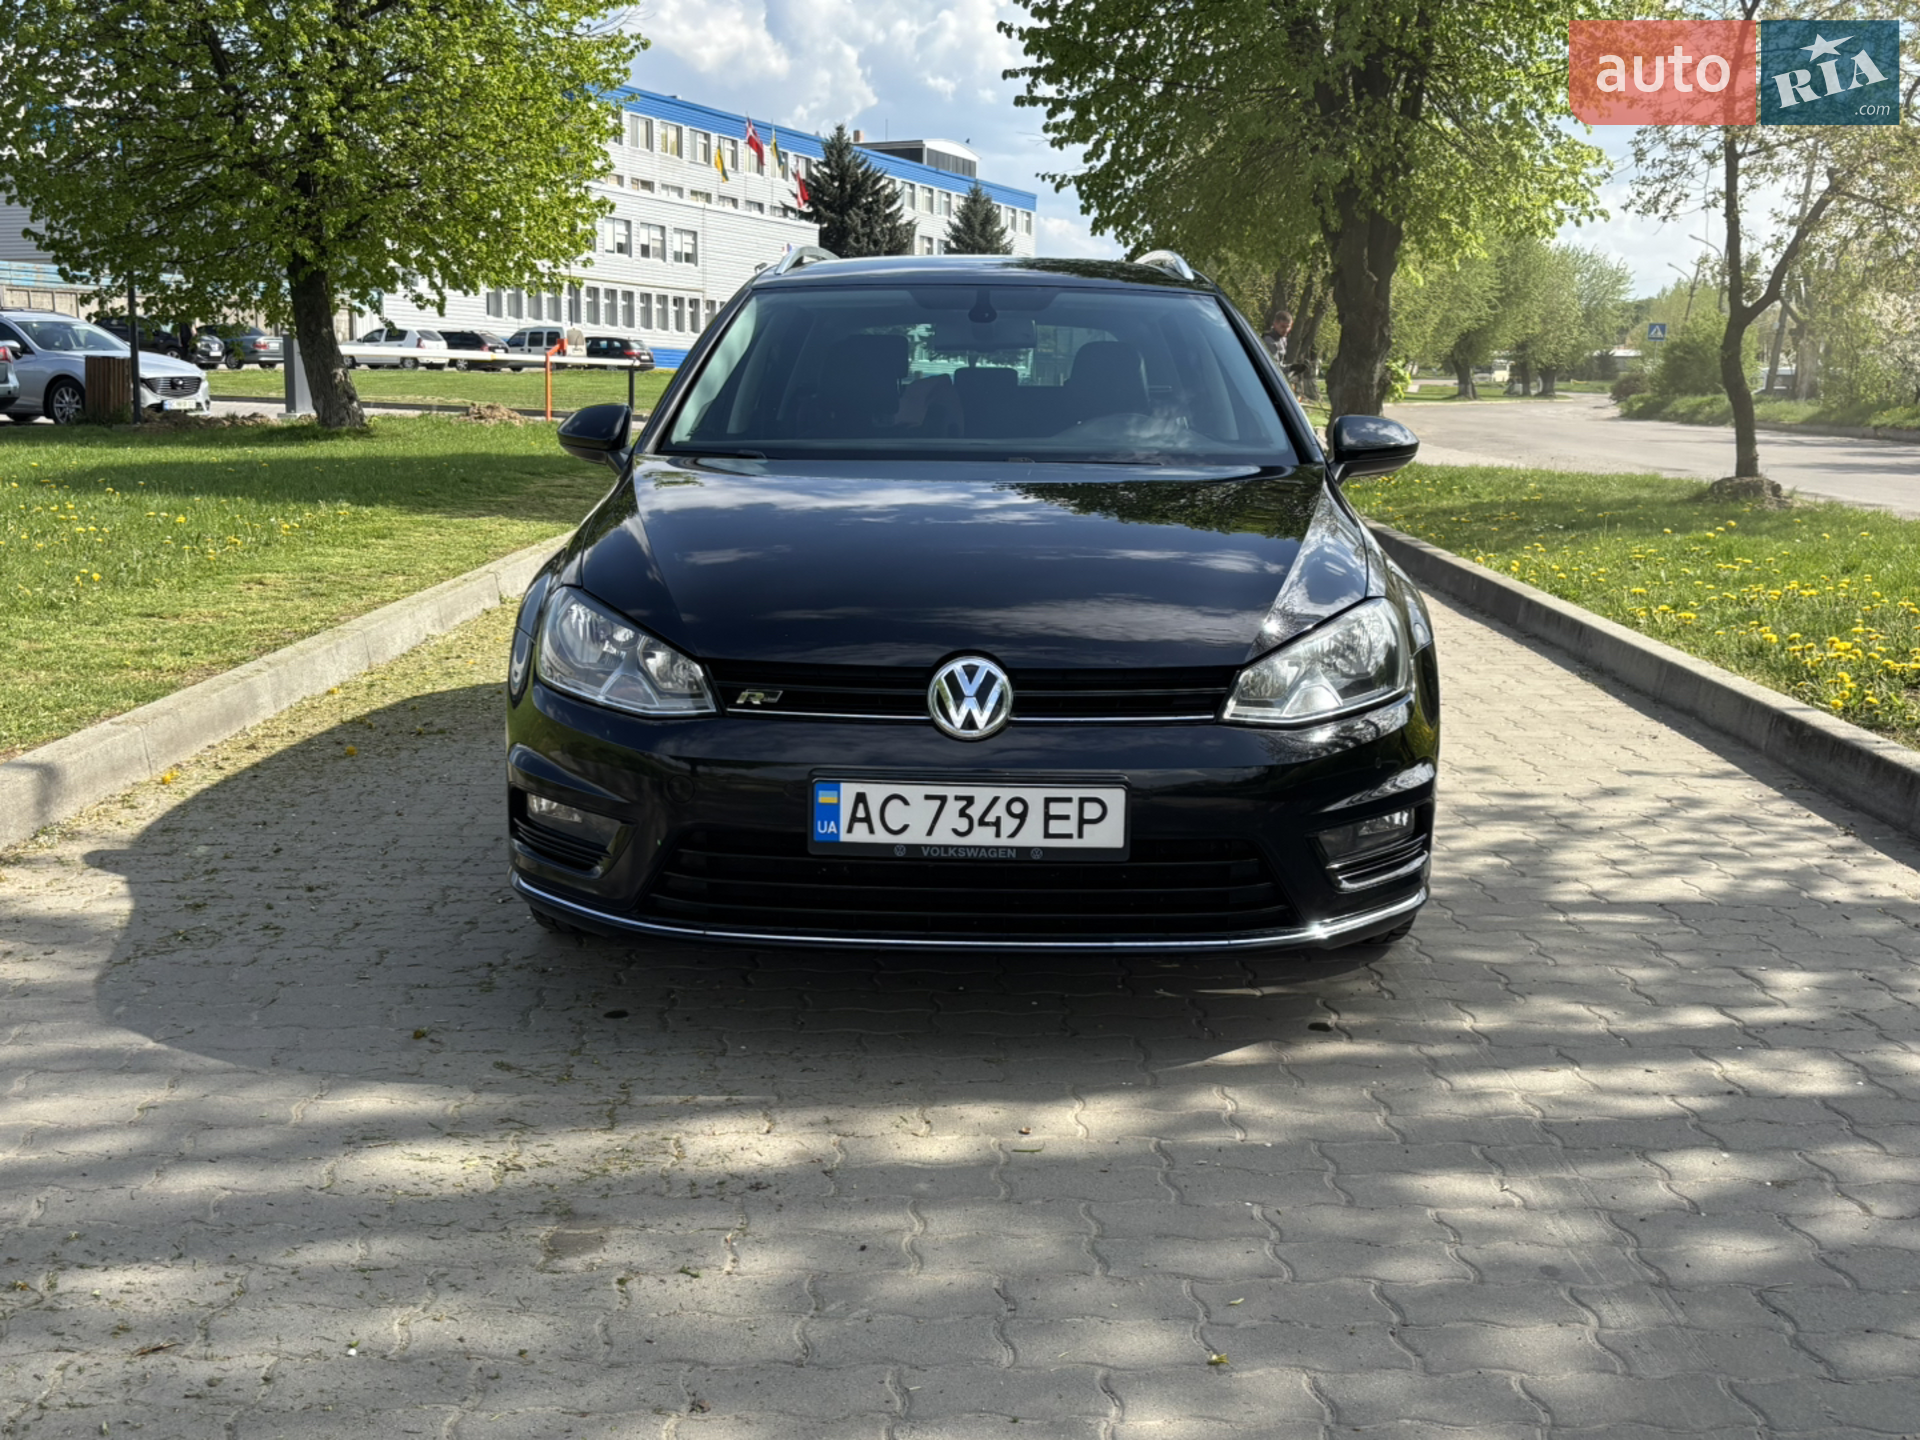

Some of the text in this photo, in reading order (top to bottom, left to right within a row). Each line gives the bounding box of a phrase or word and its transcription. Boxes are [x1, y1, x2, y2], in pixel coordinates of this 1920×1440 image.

[846, 792, 1108, 839] AC 7349 EP
[817, 820, 838, 834] UA
[921, 846, 1017, 859] VOLKSWAGEN
